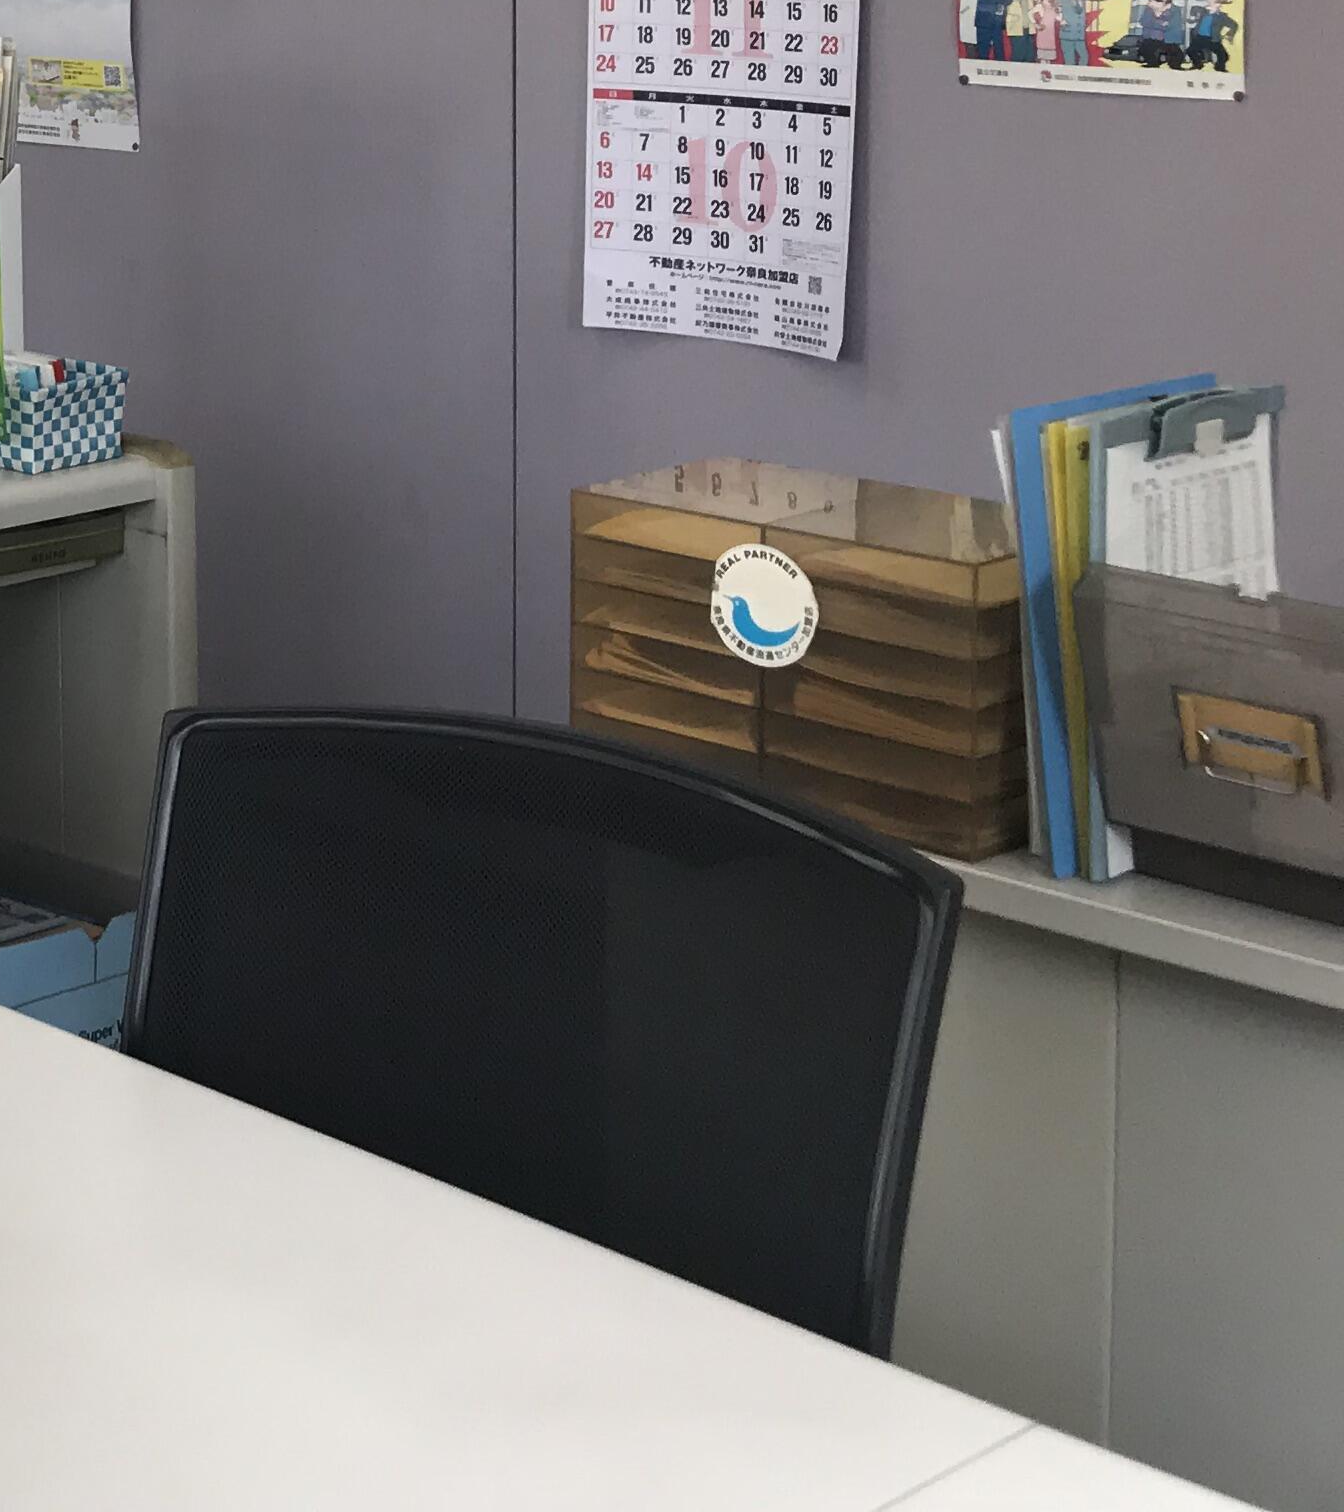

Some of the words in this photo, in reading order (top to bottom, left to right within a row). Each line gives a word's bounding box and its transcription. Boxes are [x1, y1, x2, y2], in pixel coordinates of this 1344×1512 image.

[748, 0, 765, 19] 14
[786, 1, 802, 21] 15
[823, 3, 838, 23] 16
[599, 24, 614, 41] 17
[637, 25, 654, 44] 18
[675, 27, 692, 46] 19
[710, 29, 730, 48] 20
[749, 30, 765, 50] 21
[784, 33, 804, 53] 22
[820, 35, 839, 55] 23
[596, 55, 617, 72] 24
[635, 55, 655, 75] 25
[673, 57, 693, 77] 26
[710, 59, 730, 79] 27
[747, 62, 767, 82] 28
[784, 64, 803, 84] 29
[819, 67, 838, 87] 30
[648, 255, 799, 284] 不動産ネットワーク奈良加盟店
[716, 553, 742, 579] REAL
[744, 550, 798, 579] PARTNER
